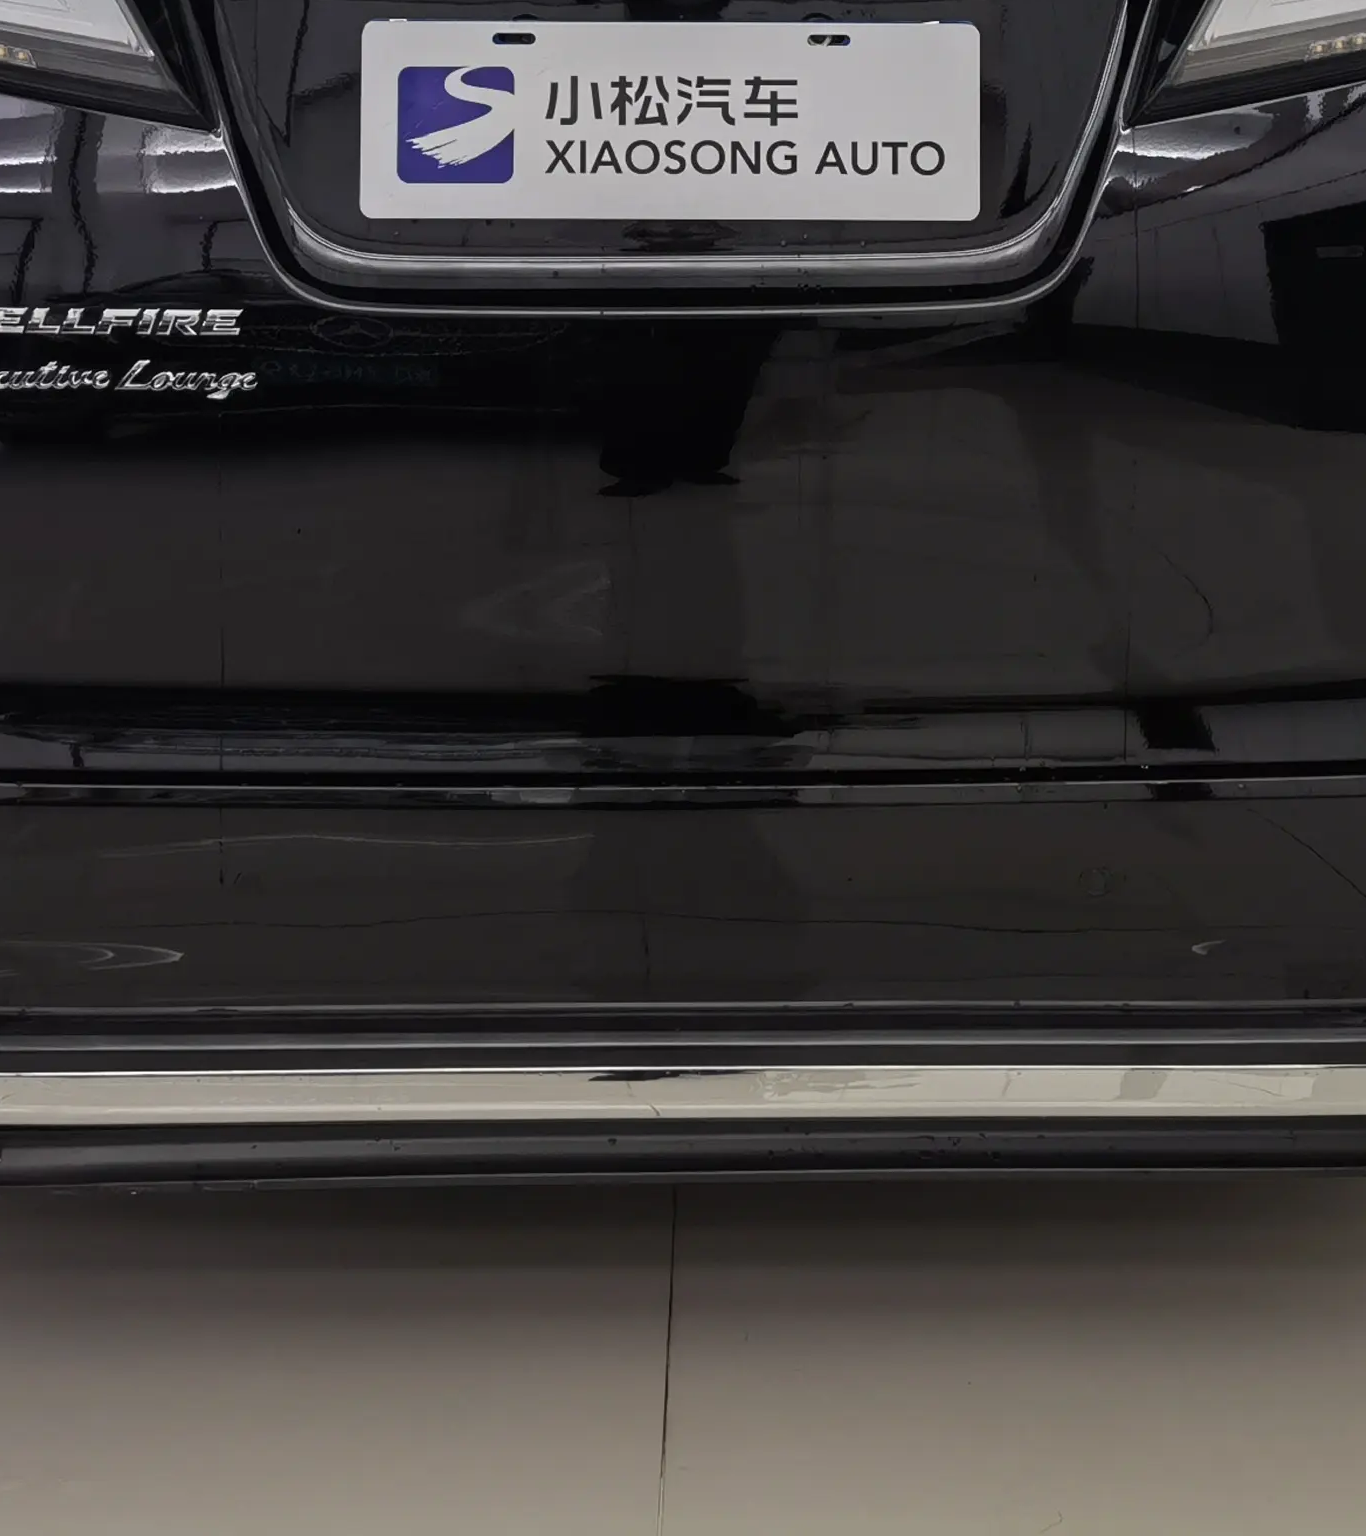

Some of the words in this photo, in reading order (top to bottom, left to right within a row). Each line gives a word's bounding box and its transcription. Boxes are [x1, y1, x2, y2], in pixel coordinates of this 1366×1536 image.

[544, 74, 800, 127] 小松汽车
[544, 139, 798, 176] XIAOSONG
[815, 140, 946, 176] AUTO
[115, 358, 259, 400] Lounge
